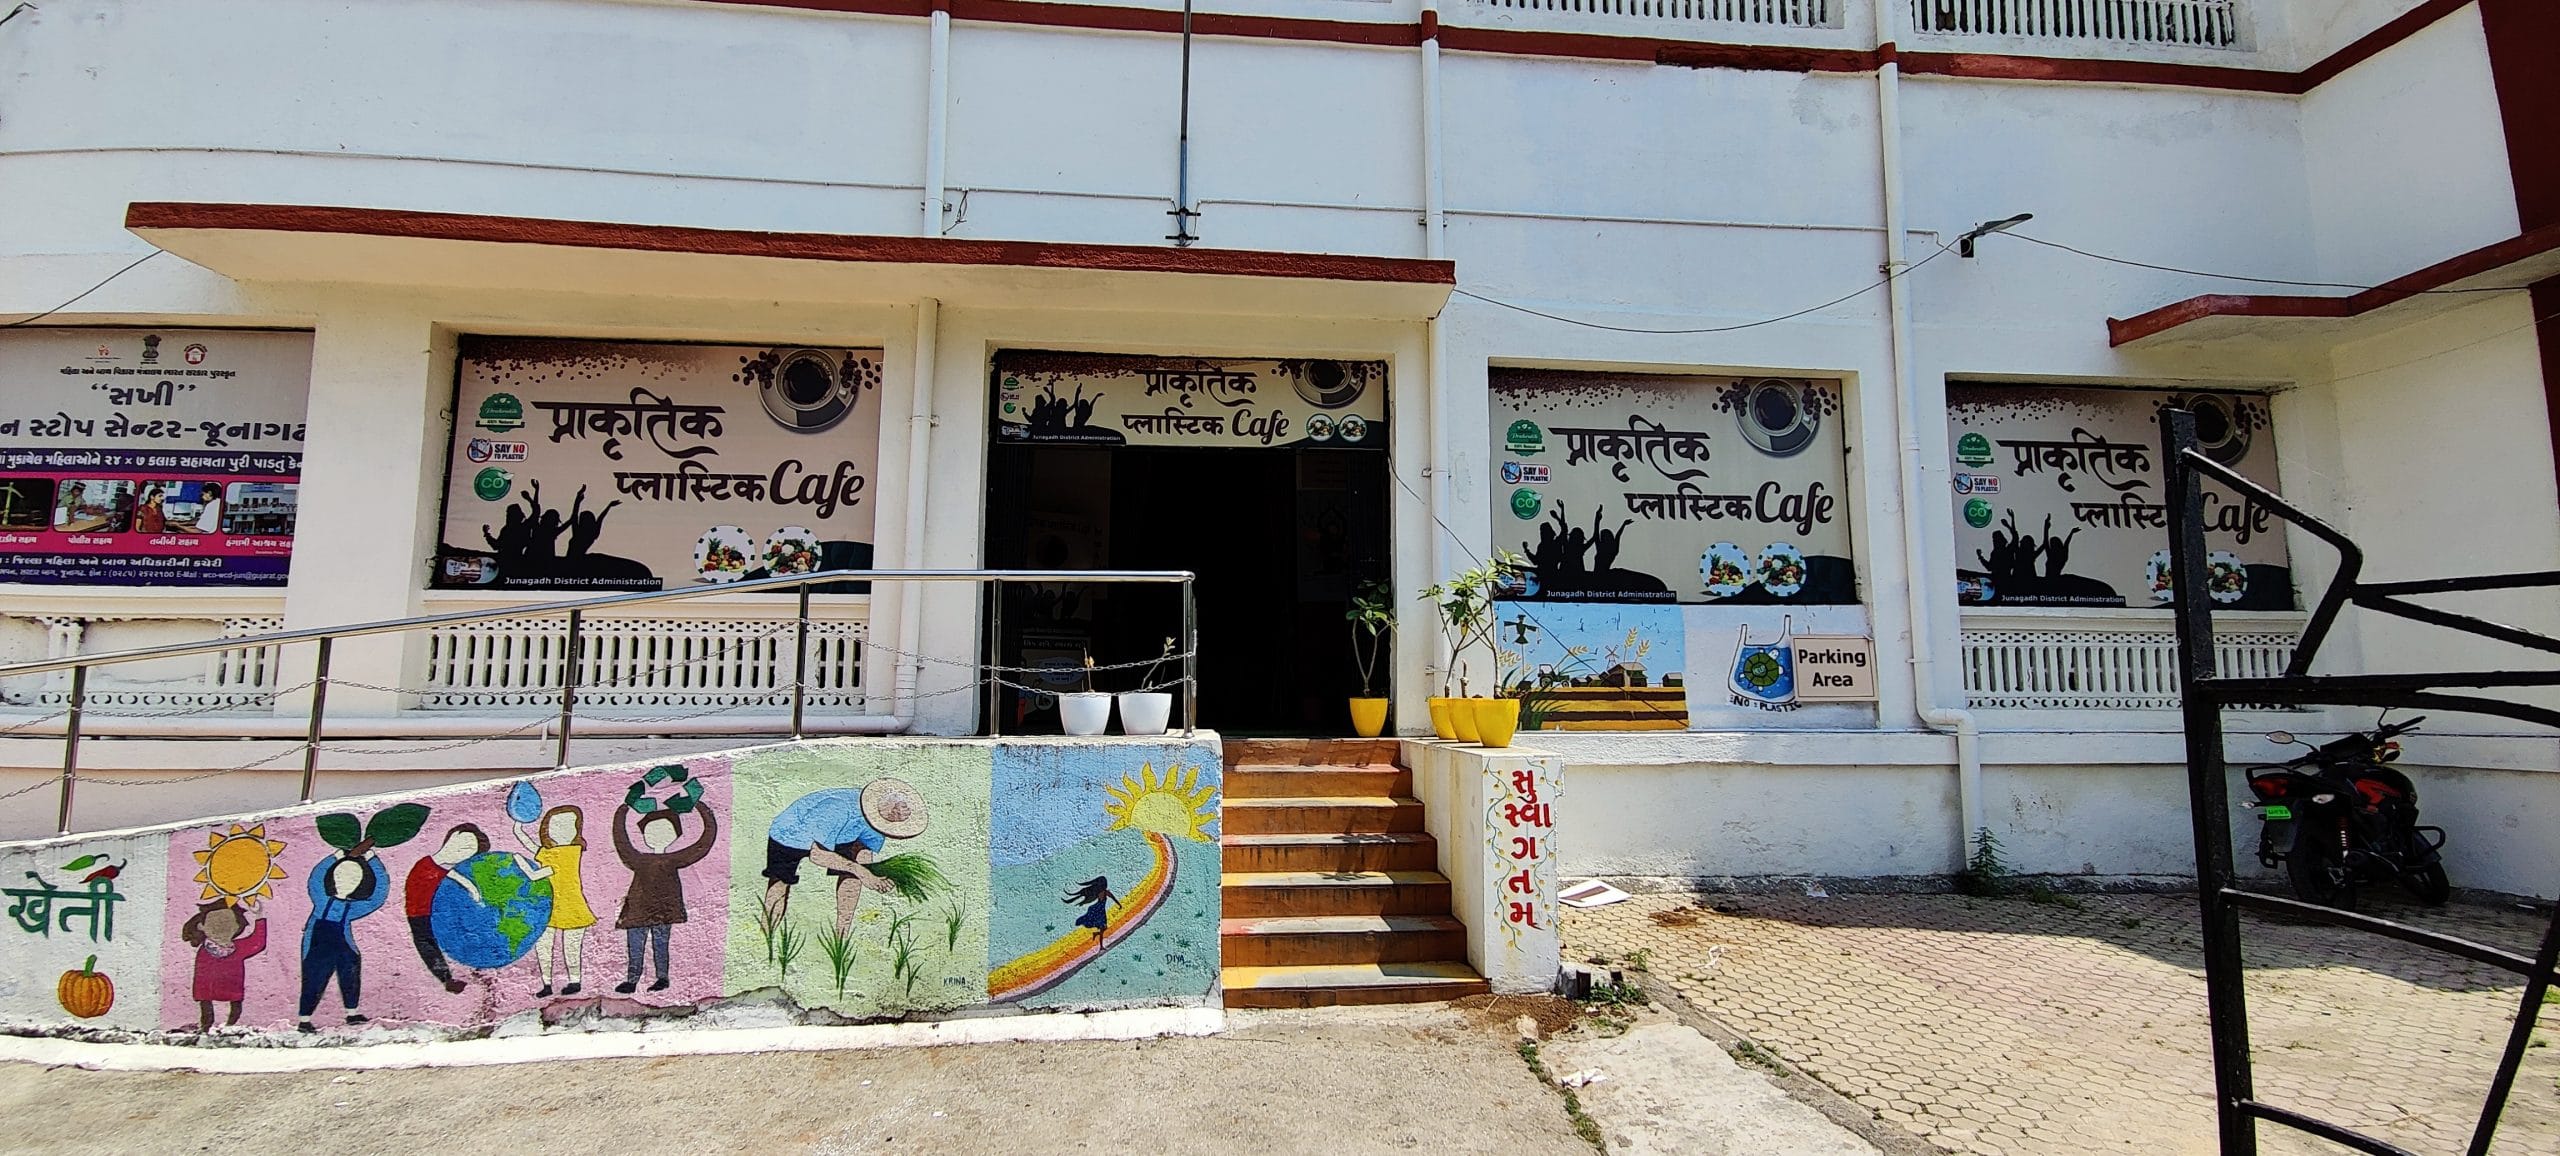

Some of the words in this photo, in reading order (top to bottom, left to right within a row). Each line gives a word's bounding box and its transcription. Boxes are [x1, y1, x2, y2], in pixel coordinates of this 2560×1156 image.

[1134, 362, 1258, 408] प्राकृतिक
[0, 420, 20, 437] ન
[30, 411, 94, 437] સ્ટોપ
[531, 387, 726, 462] प्राकृतिक
[1121, 407, 1226, 438] प्लास्टिक
[1232, 409, 1290, 445] Cafe
[494, 444, 511, 453] SAY
[512, 444, 526, 453] NO
[1548, 414, 1711, 483] प्राकृतिक
[45, 451, 101, 466] મહિલાઓને
[105, 455, 121, 466] ૨૪
[148, 456, 176, 467] કલાક
[180, 456, 225, 468] સહાયતા
[229, 454, 250, 472] પુરી
[254, 455, 285, 473] પાડતું
[1995, 427, 2152, 493] प्राकृतिक
[1523, 467, 1537, 475] SAY
[1538, 467, 1548, 475] NO
[614, 460, 767, 503] प्लास्टिक
[769, 459, 865, 519] Cafe
[1623, 483, 1752, 521] प्लास्टिक
[1755, 481, 1834, 536] Cafe
[2070, 493, 2168, 530] प्लास्टि
[150, 536, 176, 545] તબીબી
[178, 538, 199, 546] સહાય
[45, 555, 75, 565] મહિલા
[79, 557, 98, 565] અને
[504, 577, 552, 587] Junagadh
[553, 577, 590, 586] District
[591, 577, 662, 586] Administration
[1547, 590, 1585, 599] Junagadh
[1586, 590, 1616, 599] District
[1617, 590, 1676, 599] Administration
[2001, 595, 2039, 603] Junagadh
[2040, 595, 2068, 603] District
[2070, 595, 2125, 603] Administration
[1799, 649, 1866, 666] Parking
[1812, 672, 1854, 687] Area
[1760, 700, 1803, 712] PLASTIC
[1, 870, 126, 943] खेती
[943, 976, 966, 987] KRINA
